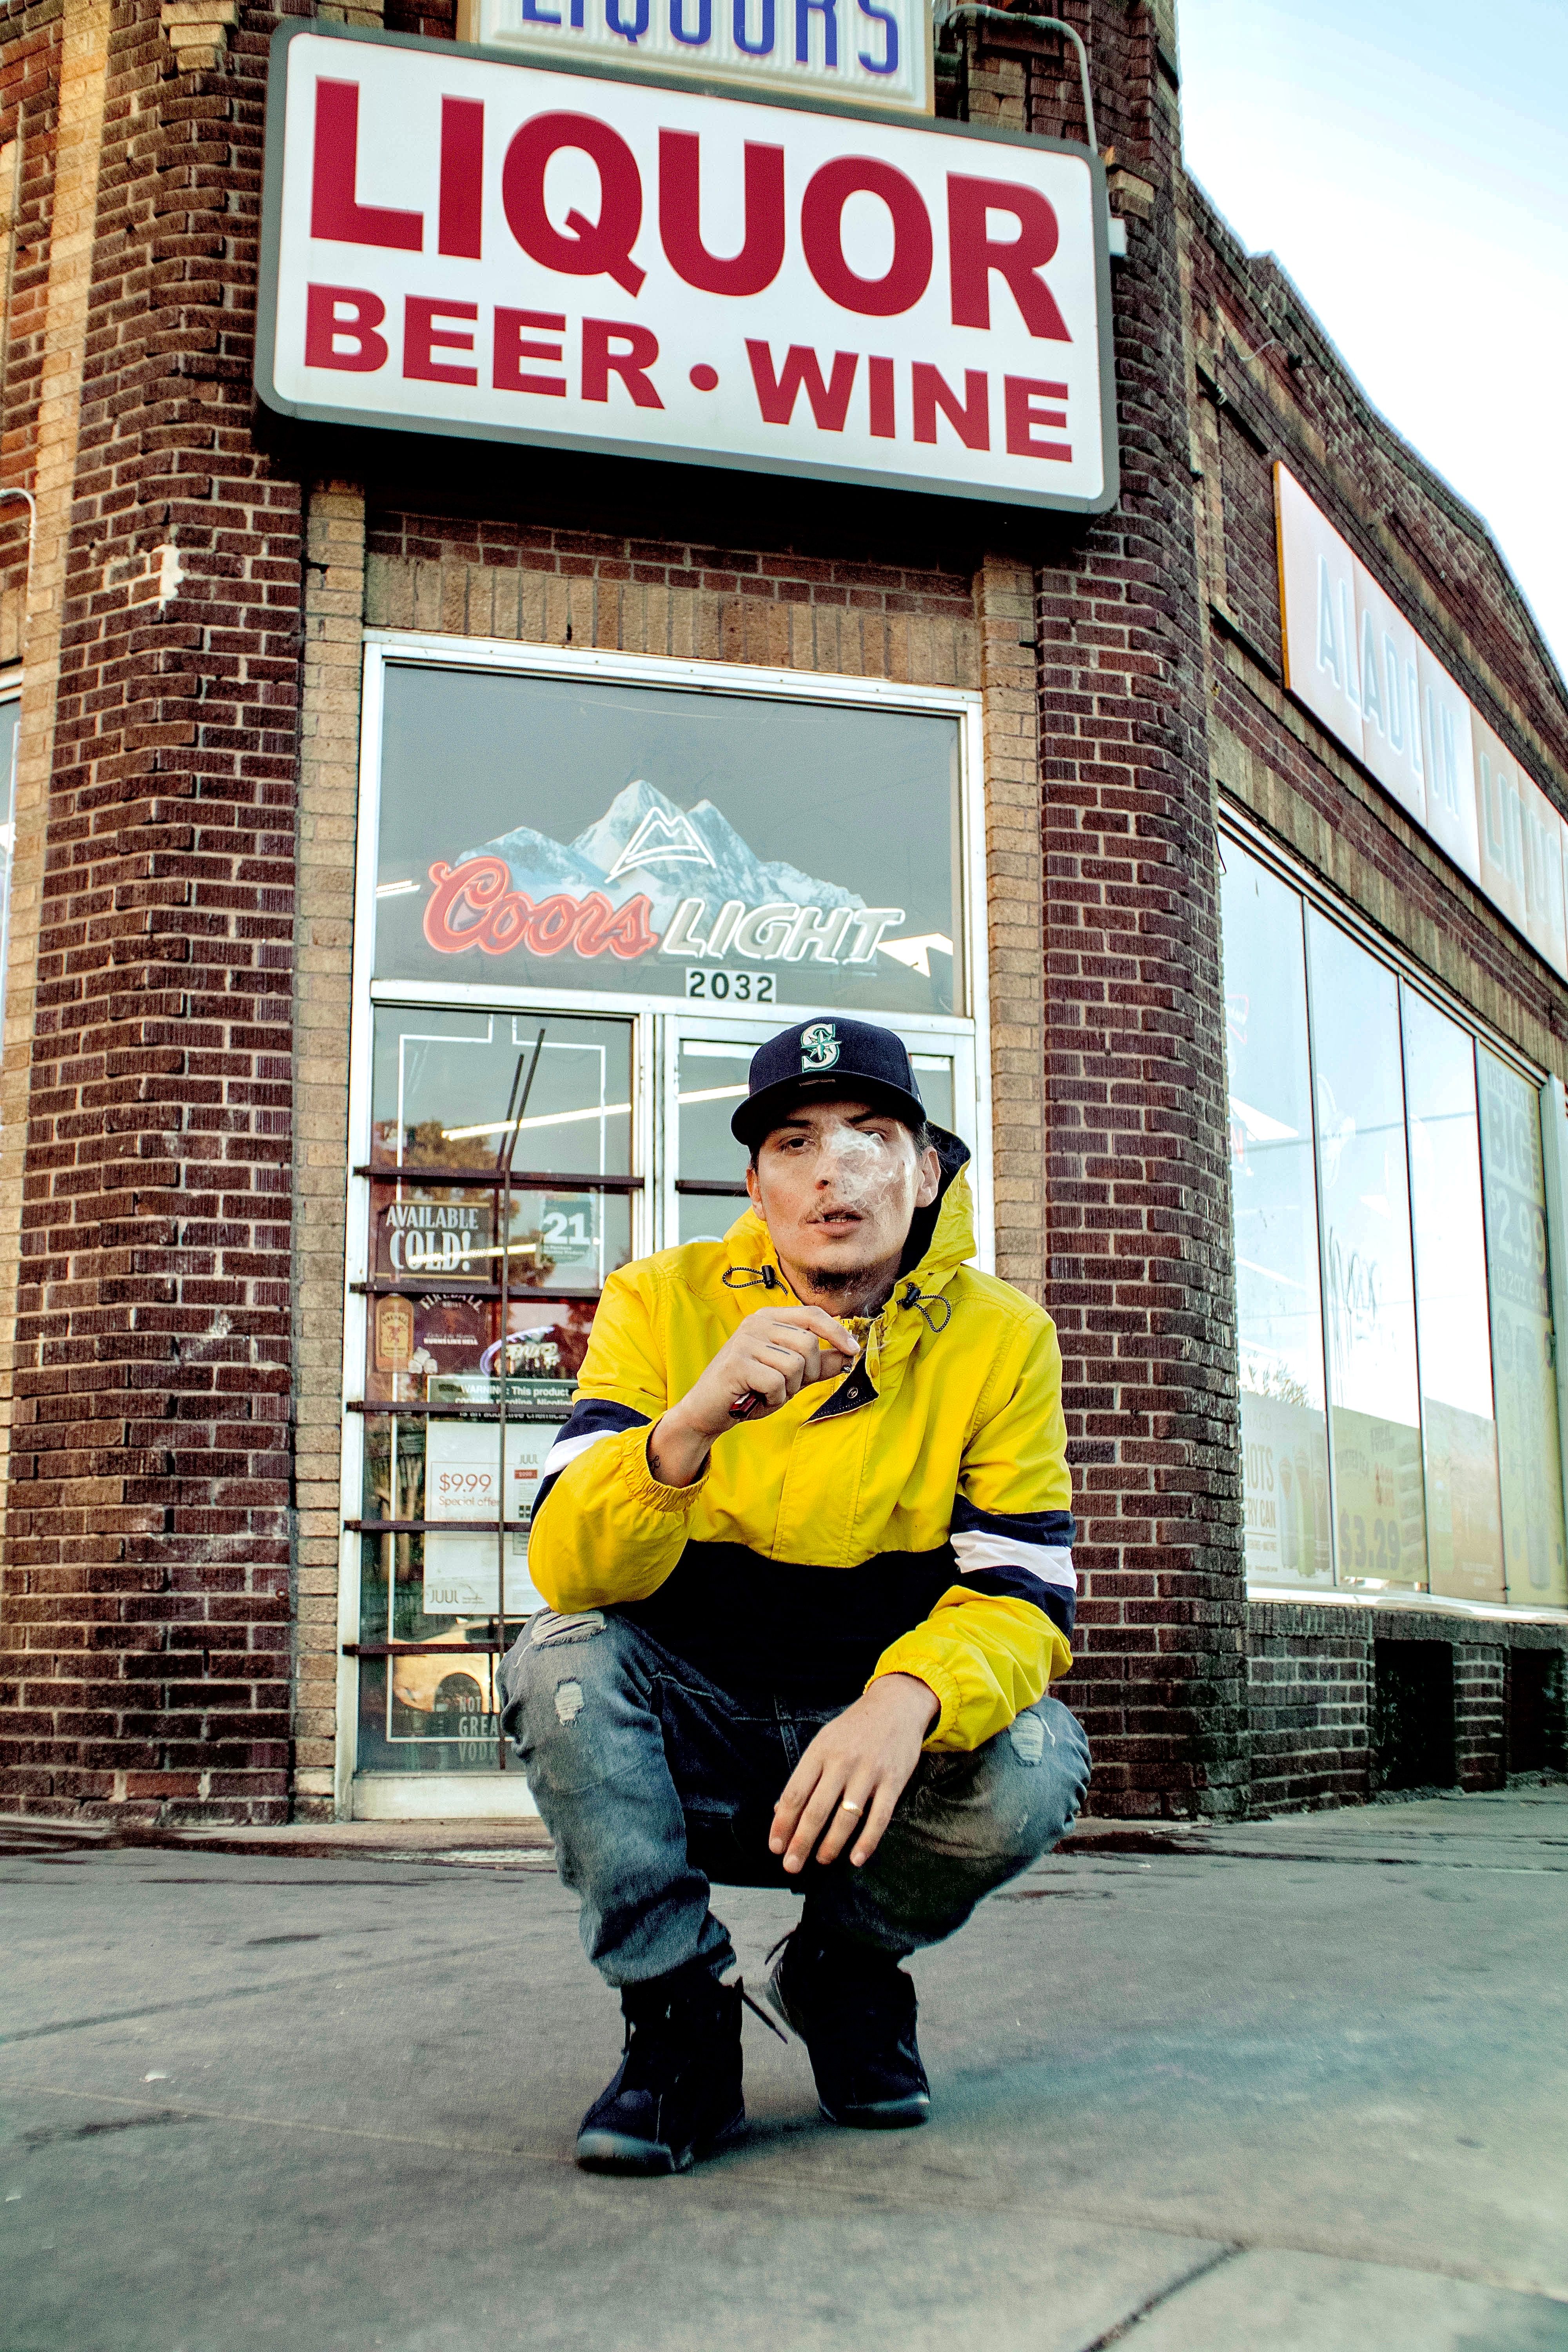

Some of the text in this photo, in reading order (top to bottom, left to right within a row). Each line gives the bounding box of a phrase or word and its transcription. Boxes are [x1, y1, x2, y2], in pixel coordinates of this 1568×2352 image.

[310, 79, 1072, 342] LIQUOR
[305, 284, 1072, 462] BEER WINE
[423, 856, 906, 964] Coors LIGHT
[690, 971, 773, 1002] 2032
[1487, 1089, 1532, 1189] BIG
[385, 1205, 478, 1230] AVAILABLE
[543, 1212, 590, 1245] 21
[390, 1230, 471, 1272] COLD!
[461, 1384, 569, 1397] WARNIN: This product
[519, 1454, 539, 1465] JUUL
[439, 1472, 492, 1493] $9.99
[438, 1495, 475, 1508] Special
[1339, 1508, 1400, 1572] $3.29
[429, 1589, 459, 1604] JUUL
[459, 1715, 499, 1737] GREA
[458, 1742, 497, 1762] VODK
